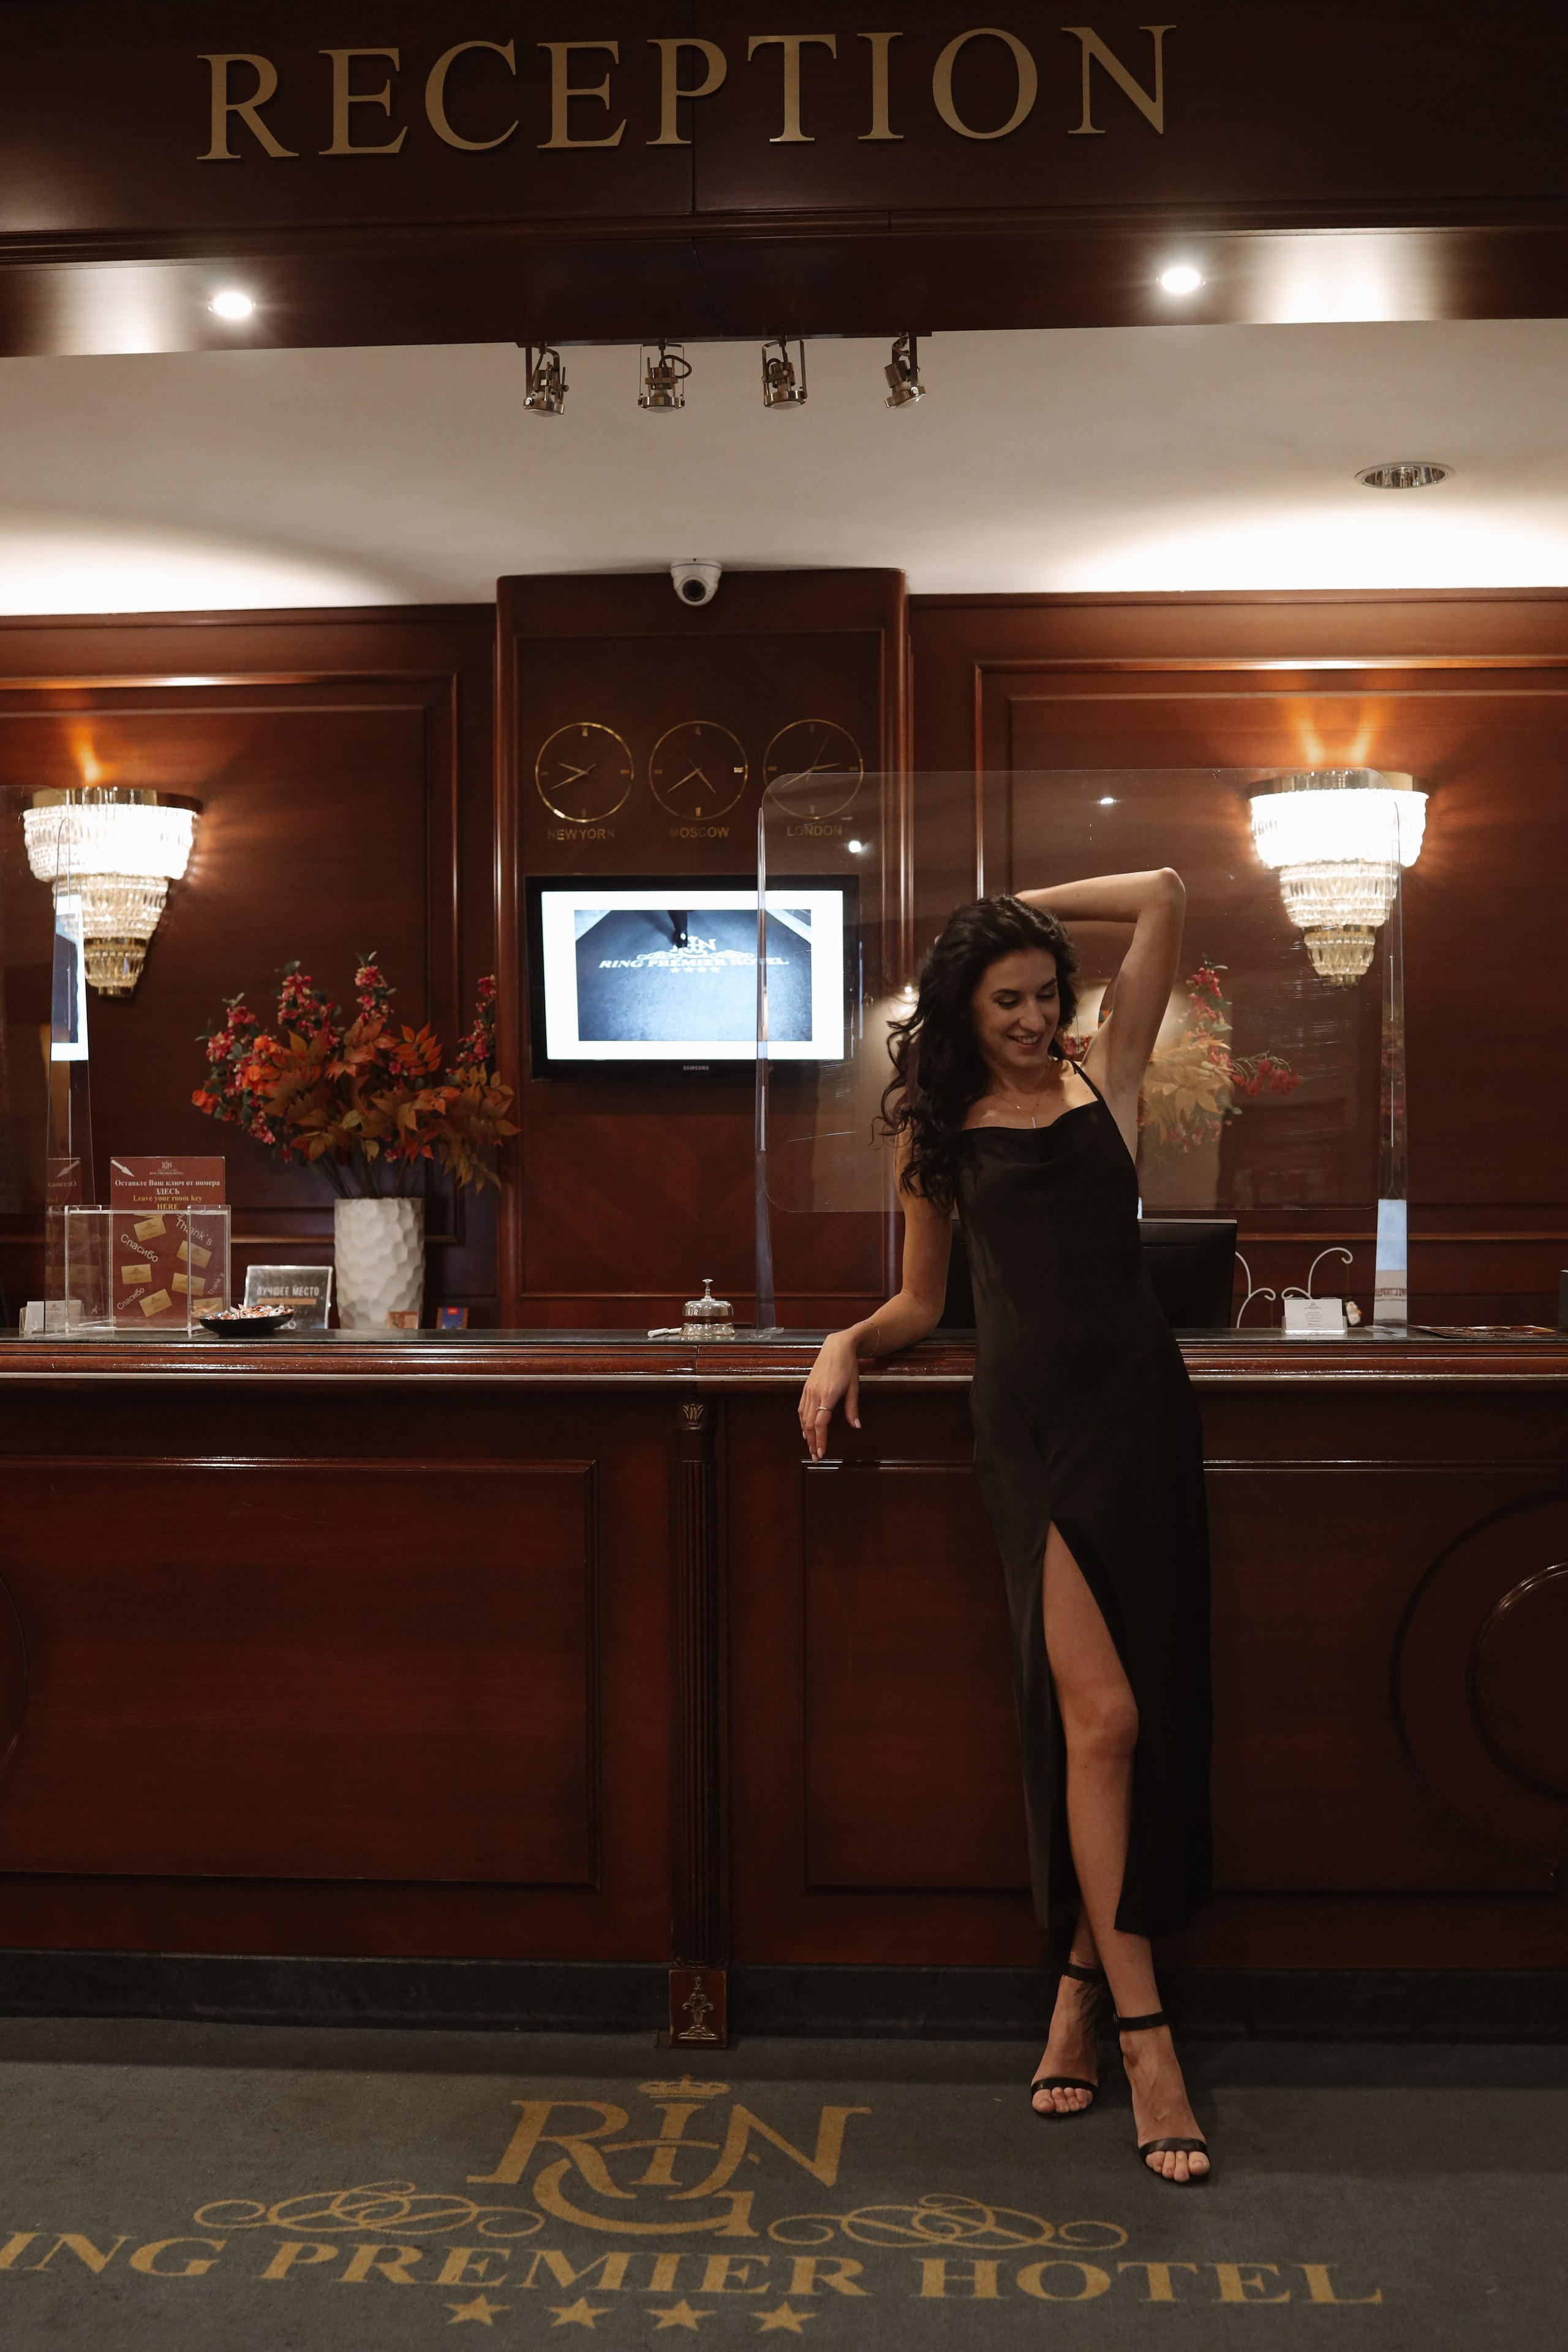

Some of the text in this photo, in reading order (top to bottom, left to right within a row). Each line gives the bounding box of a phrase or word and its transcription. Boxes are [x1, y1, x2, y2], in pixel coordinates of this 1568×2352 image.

[196, 23, 1177, 162] RECEPTION
[548, 829, 615, 841] NEW YORK
[669, 826, 729, 839] MOSCOW
[787, 825, 842, 837] LONDON
[599, 957, 790, 968] RING PREMIER HOEL
[120, 1234, 159, 1263] Спасибо
[257, 1286, 320, 1297] ЛУЧШЕЕ МЕСТО
[116, 1287, 145, 1310] Спасибо
[256, 2242, 872, 2297] PREMIER
[915, 2259, 1383, 2305] HOTEL
